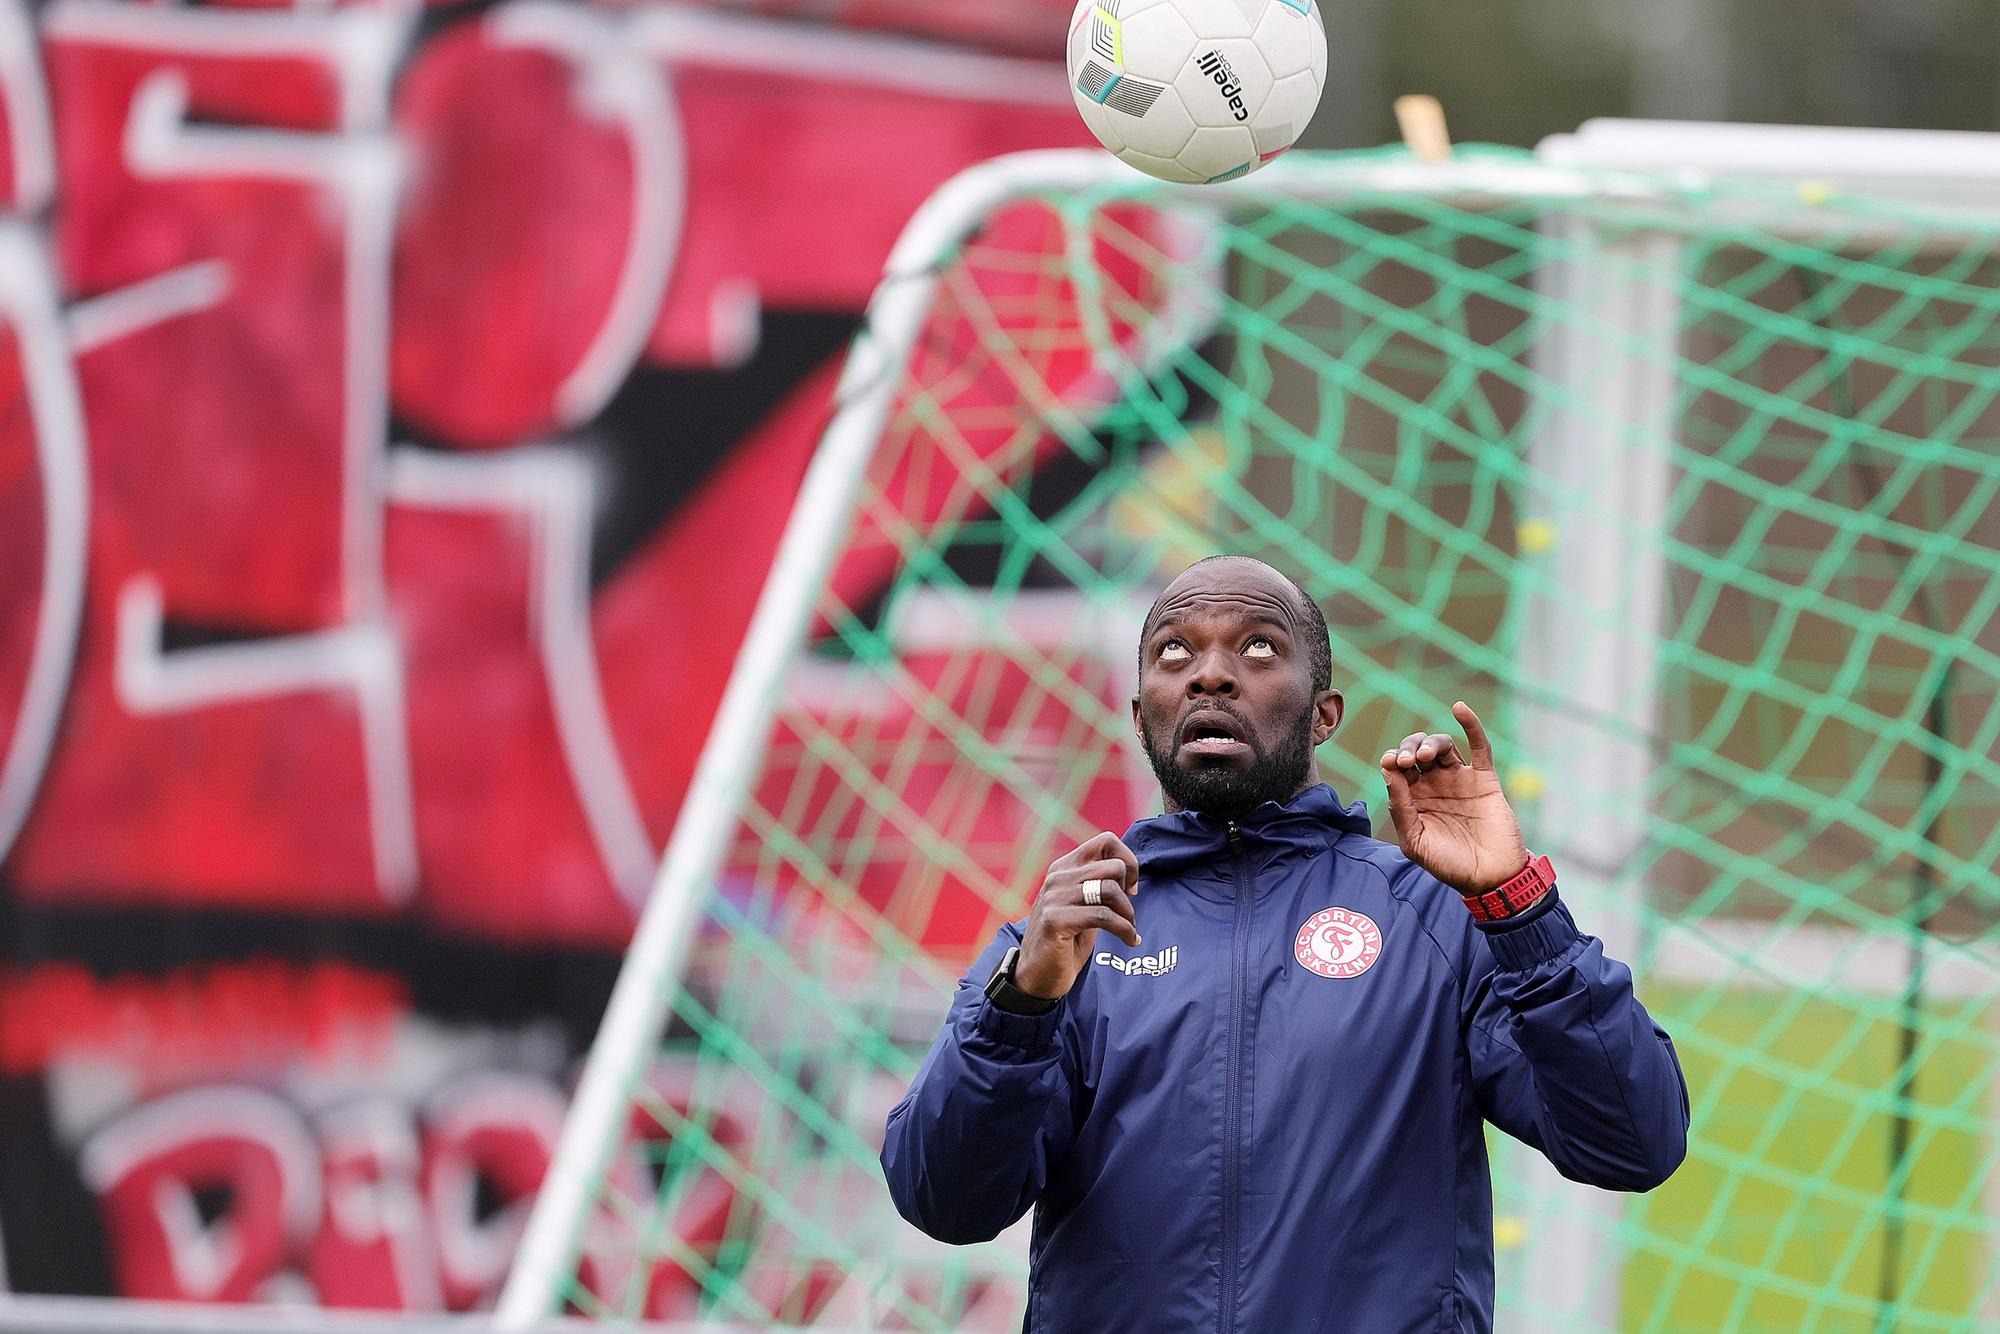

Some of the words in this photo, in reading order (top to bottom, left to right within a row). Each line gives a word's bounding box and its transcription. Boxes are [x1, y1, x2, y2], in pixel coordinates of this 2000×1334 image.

[1213, 49, 1241, 86] SPORT
[1196, 51, 1249, 121] capelli
[1307, 910, 1378, 955] FORTUNA
[1095, 945, 1178, 976] capelli
[1132, 963, 1177, 977] SPORT
[1310, 957, 1367, 975] KÖLN
